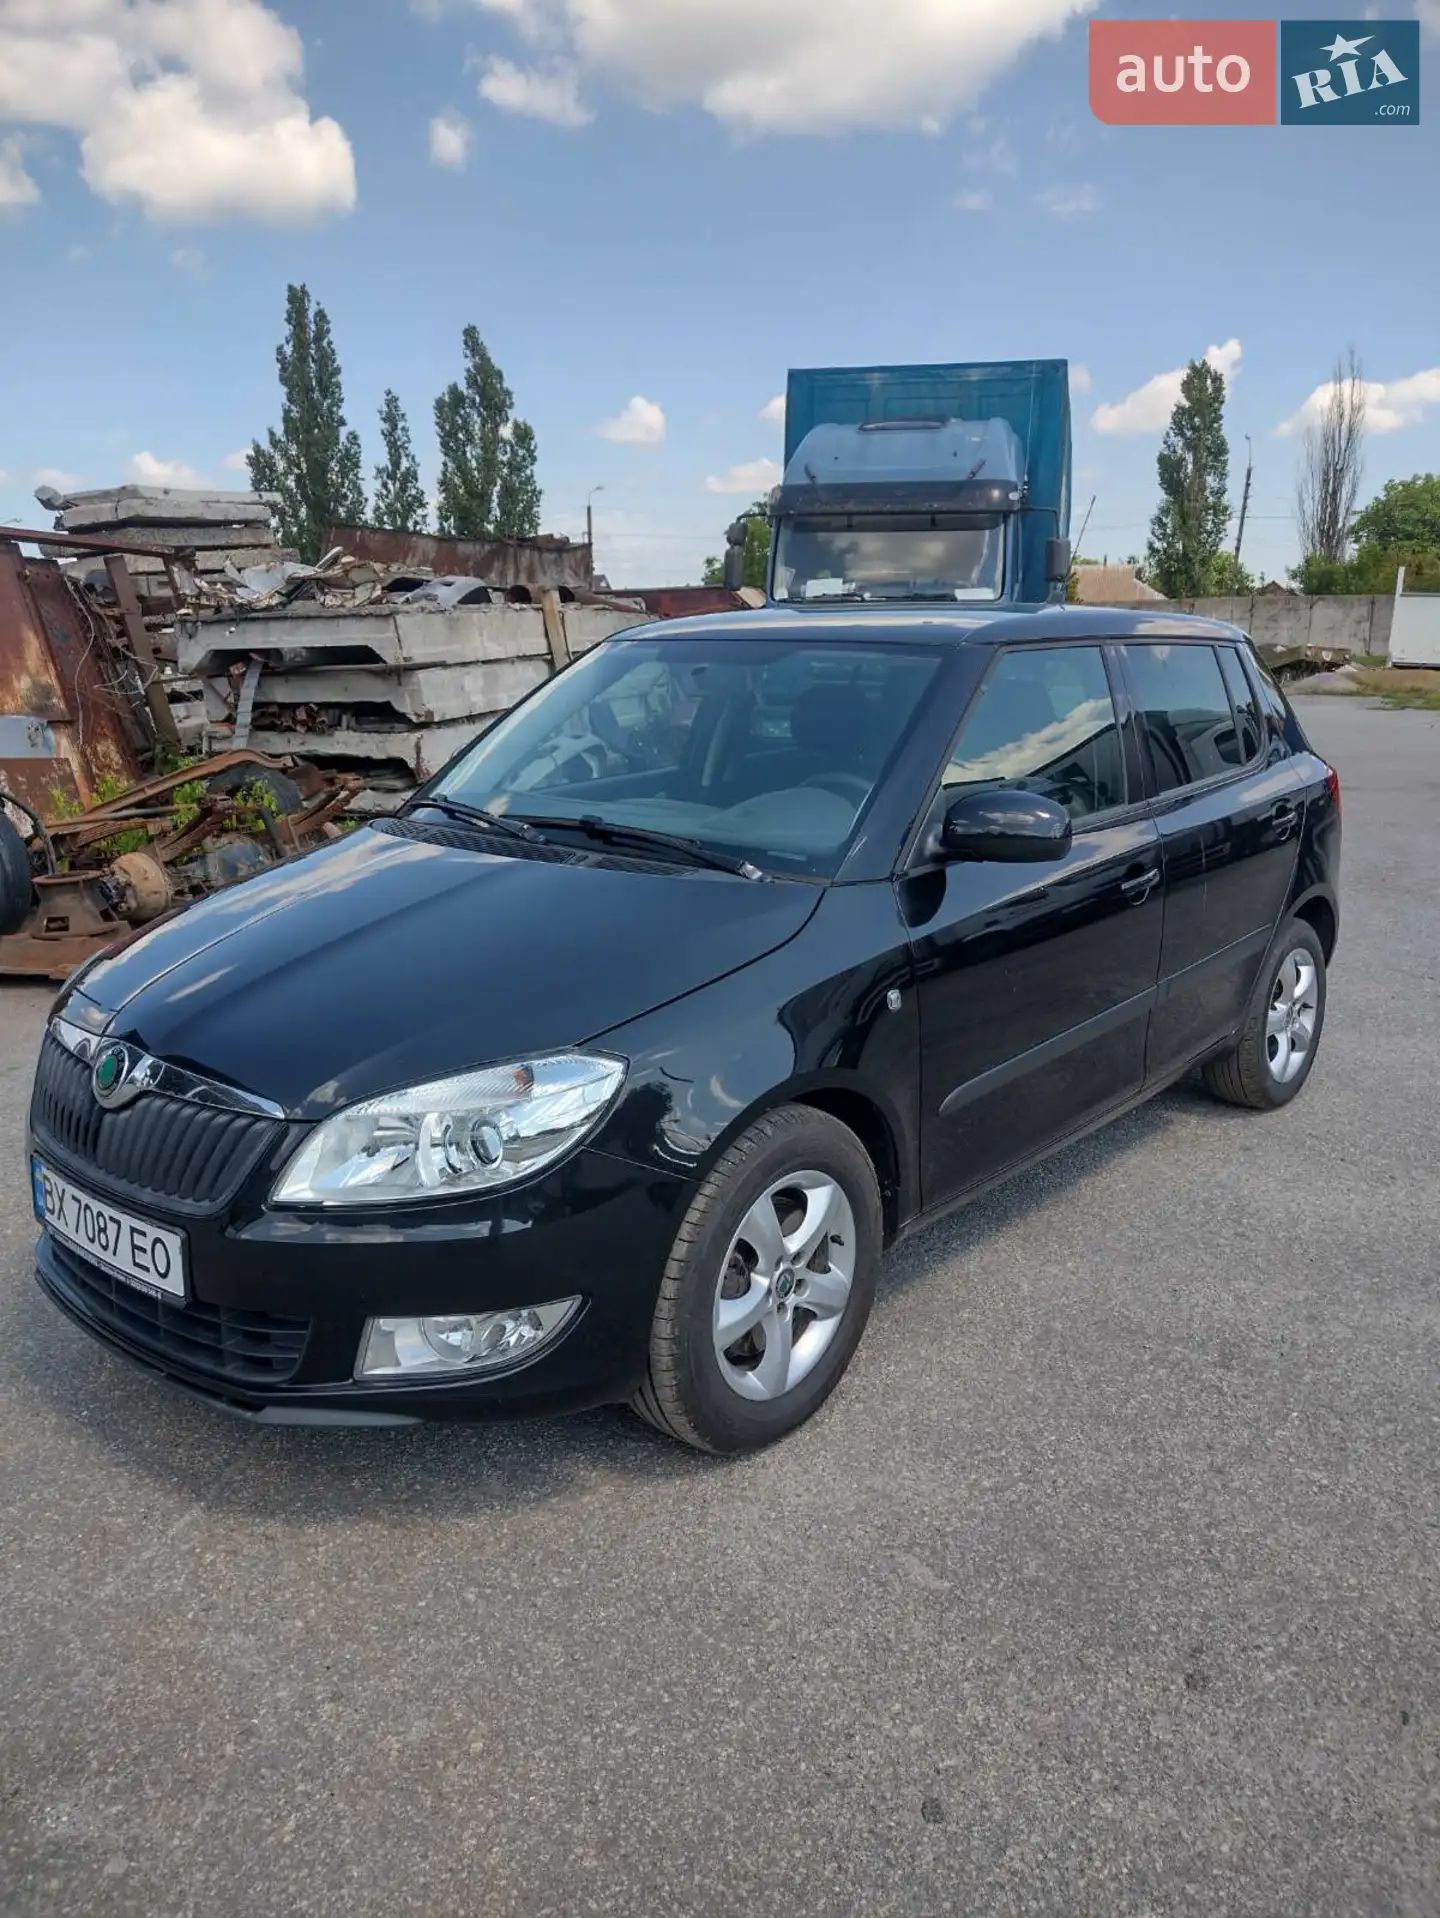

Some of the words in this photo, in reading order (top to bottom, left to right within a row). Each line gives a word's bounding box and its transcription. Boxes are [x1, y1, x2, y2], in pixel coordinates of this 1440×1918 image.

[43, 1173, 69, 1228] BX
[71, 1194, 122, 1257] 7087
[129, 1225, 171, 1279] EO
